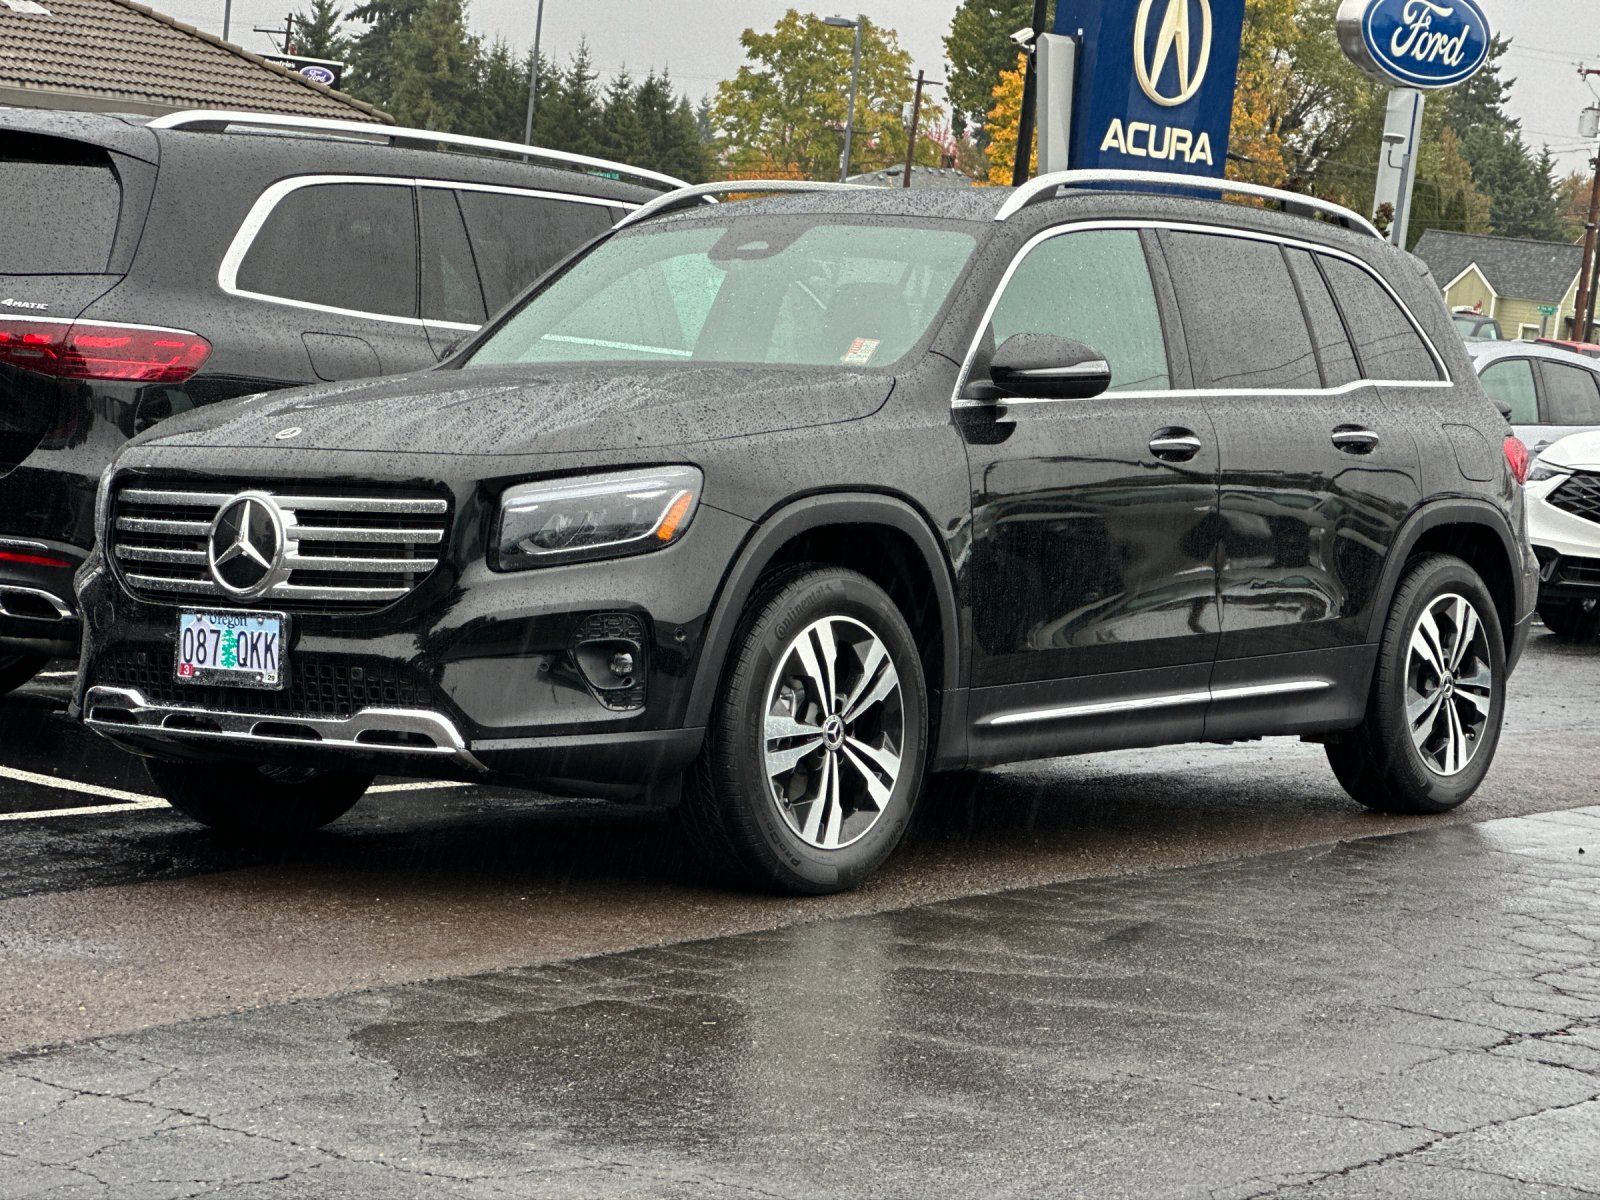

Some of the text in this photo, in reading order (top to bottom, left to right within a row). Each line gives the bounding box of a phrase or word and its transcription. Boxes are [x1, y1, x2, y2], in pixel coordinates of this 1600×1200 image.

[1391, 0, 1470, 67] Ford
[1100, 118, 1213, 166] ACURA
[0, 298, 49, 310] 4MATIC
[209, 614, 248, 629] Oregon
[183, 627, 277, 670] 087 QKK
[183, 664, 190, 675] 3
